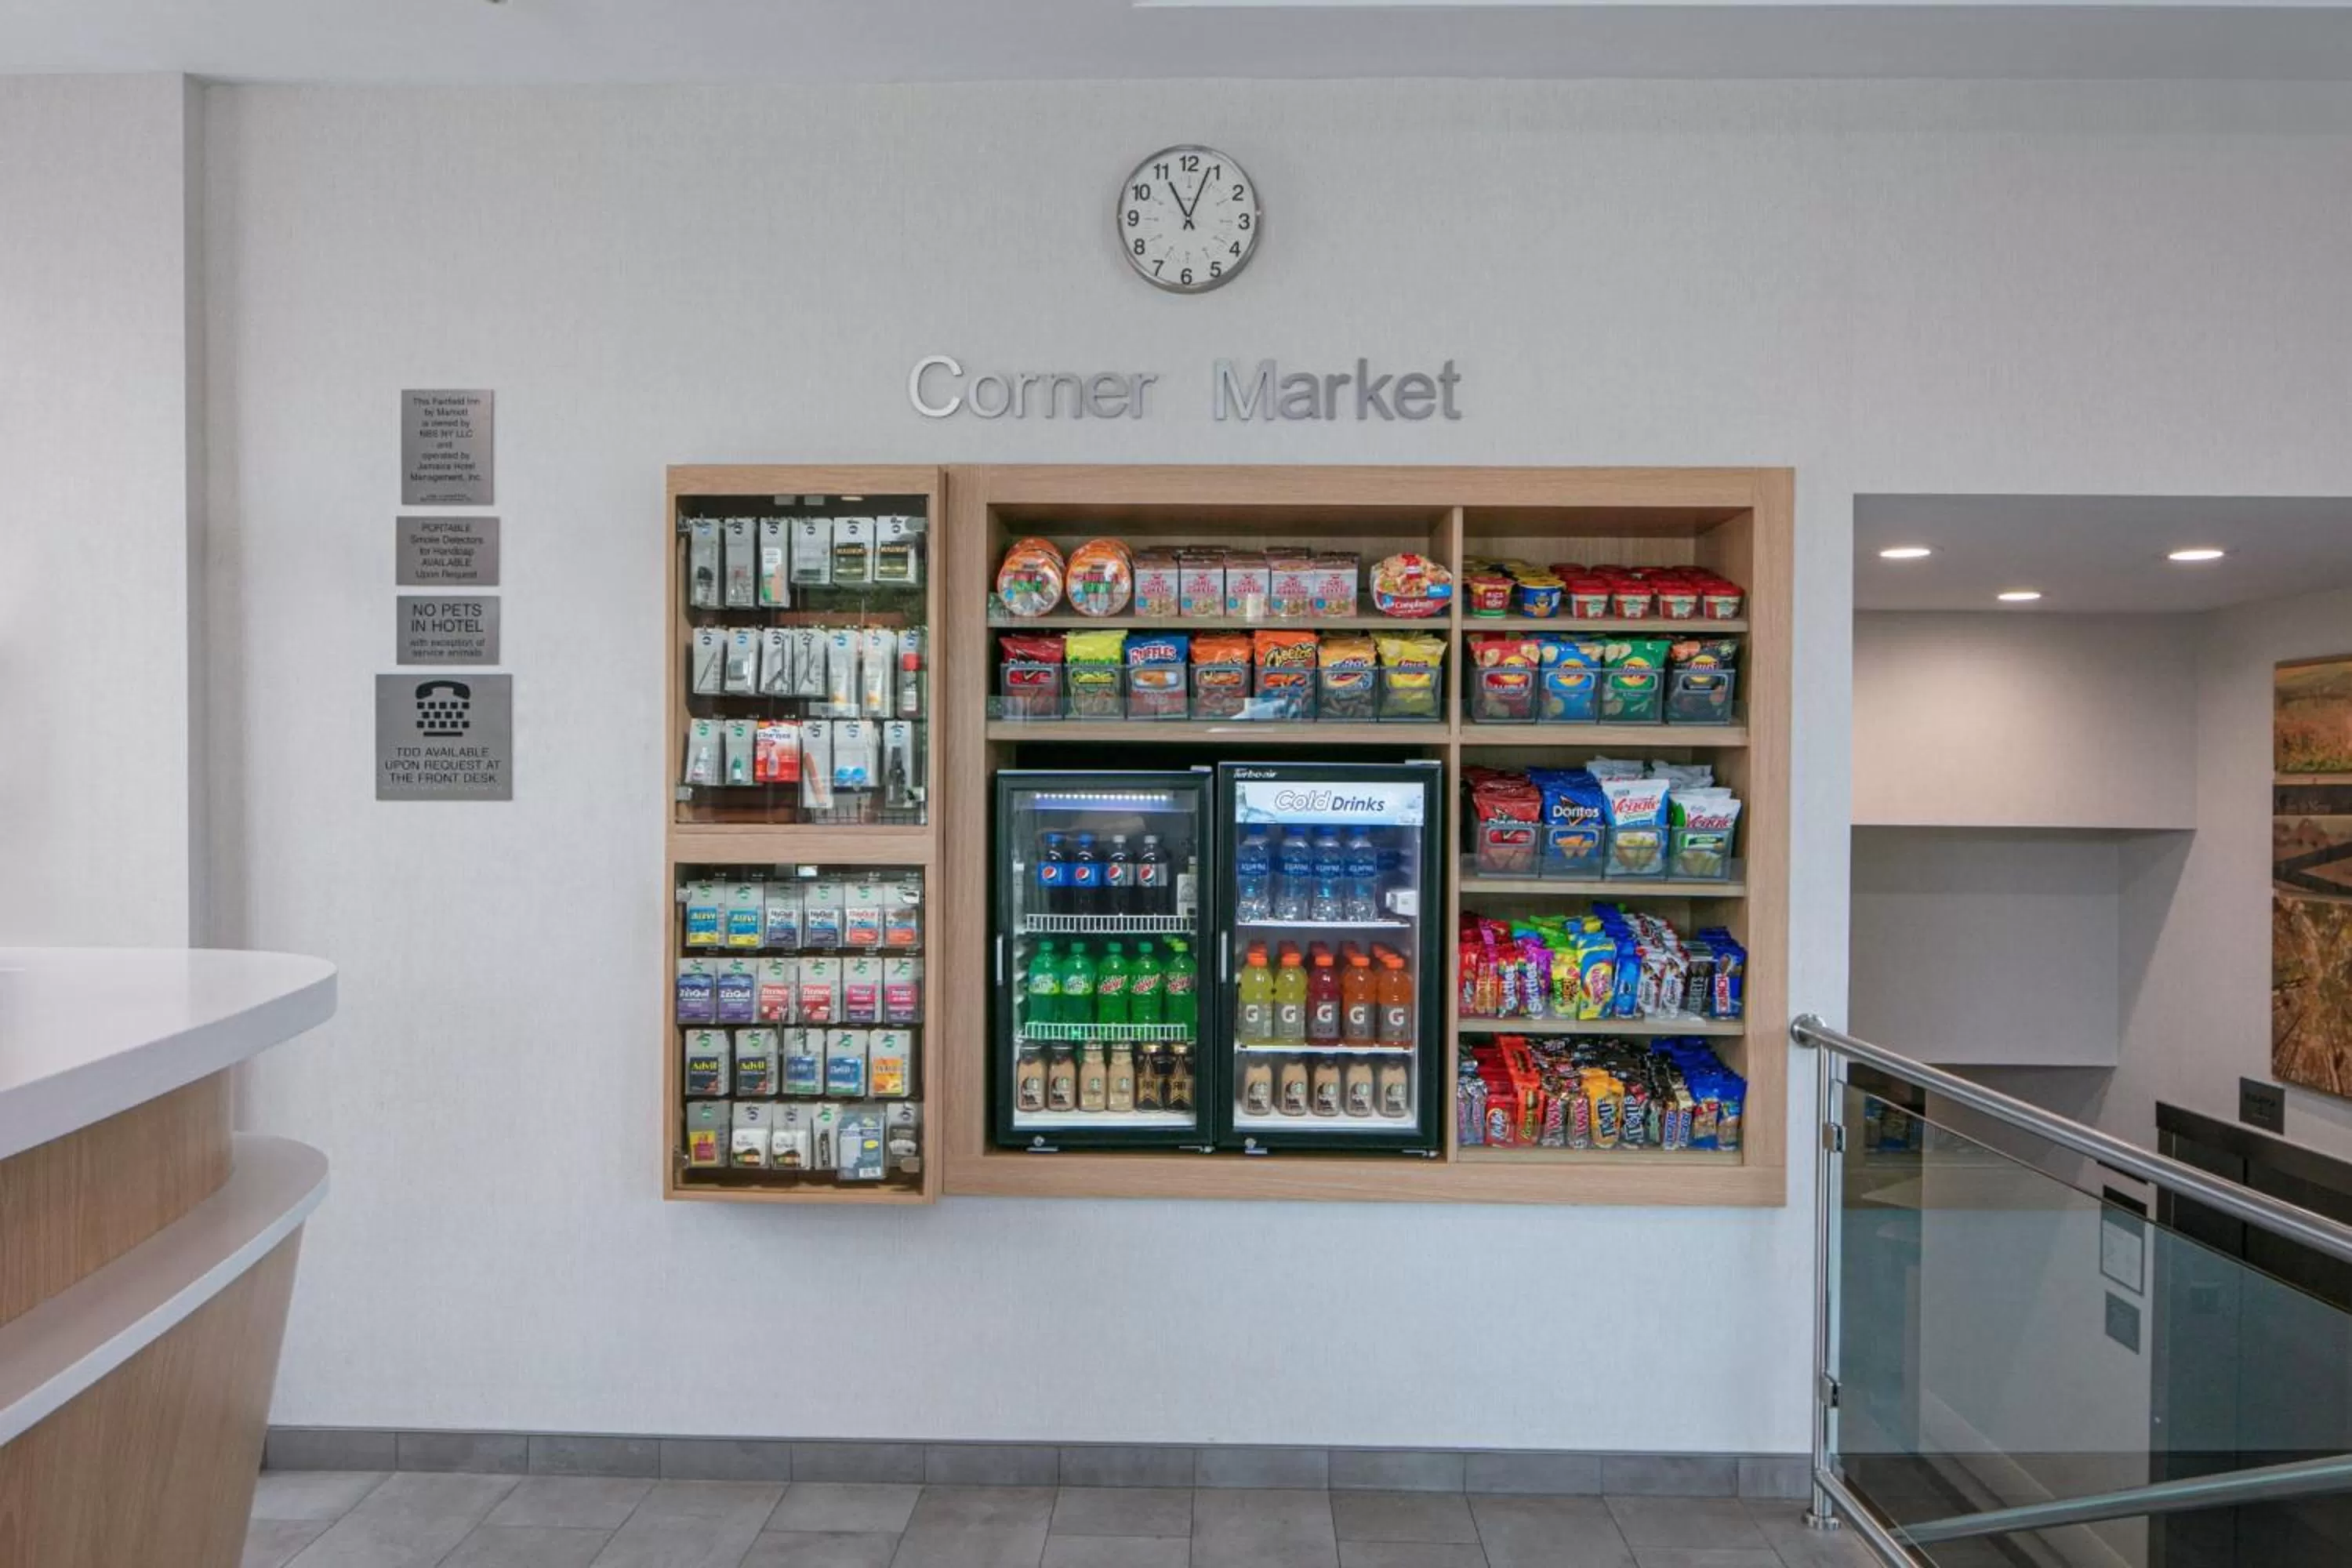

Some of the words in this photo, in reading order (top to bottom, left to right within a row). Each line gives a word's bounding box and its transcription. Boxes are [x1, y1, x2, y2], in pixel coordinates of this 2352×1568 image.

[1154, 163, 1169, 180] 11
[1179, 155, 1200, 172] 12
[1213, 164, 1221, 180] 1
[1132, 183, 1150, 200] 10
[1232, 184, 1244, 201] 2
[1127, 209, 1139, 227] 9
[1238, 212, 1250, 230] 3
[1134, 238, 1145, 255] 8
[1229, 241, 1240, 257] 4
[1152, 260, 1164, 276] 7
[1181, 267, 1192, 285] 6
[1210, 261, 1222, 278] 5
[907, 354, 1159, 420] Corner
[1213, 358, 1463, 422] Market
[422, 452, 458, 461] operated
[421, 523, 470, 532] PORTABLE
[410, 535, 440, 544] Smoke
[442, 535, 484, 544] Detectors
[419, 547, 430, 556] for
[433, 547, 474, 557] Handicap
[421, 558, 471, 567] AVAILABLE
[416, 570, 440, 579] Upon
[441, 570, 477, 579] Request
[413, 603, 436, 617] NO
[441, 603, 482, 617] PETS
[411, 619, 426, 633] IN
[432, 619, 484, 633] HOTEL
[431, 639, 474, 649] exception
[448, 648, 483, 657] animals
[1130, 645, 1177, 663] RUFFLES
[1265, 643, 1314, 667] Cheetos
[396, 747, 421, 757] TDD
[425, 747, 490, 757] AVAILABLE
[385, 760, 420, 770] UPON
[424, 760, 483, 771] REQUEST
[486, 760, 502, 770] AT
[390, 772, 414, 783] THE
[418, 773, 459, 783] FRONT
[463, 773, 496, 783] DESK
[1275, 789, 1332, 811] Cold
[1333, 796, 1385, 811] Drinks
[1552, 805, 1600, 819] Doritos
[1246, 1005, 1258, 1022] G
[1282, 1005, 1296, 1022] G
[1316, 1005, 1332, 1022] G
[1349, 1007, 1365, 1024] G
[1388, 1008, 1404, 1025] G
